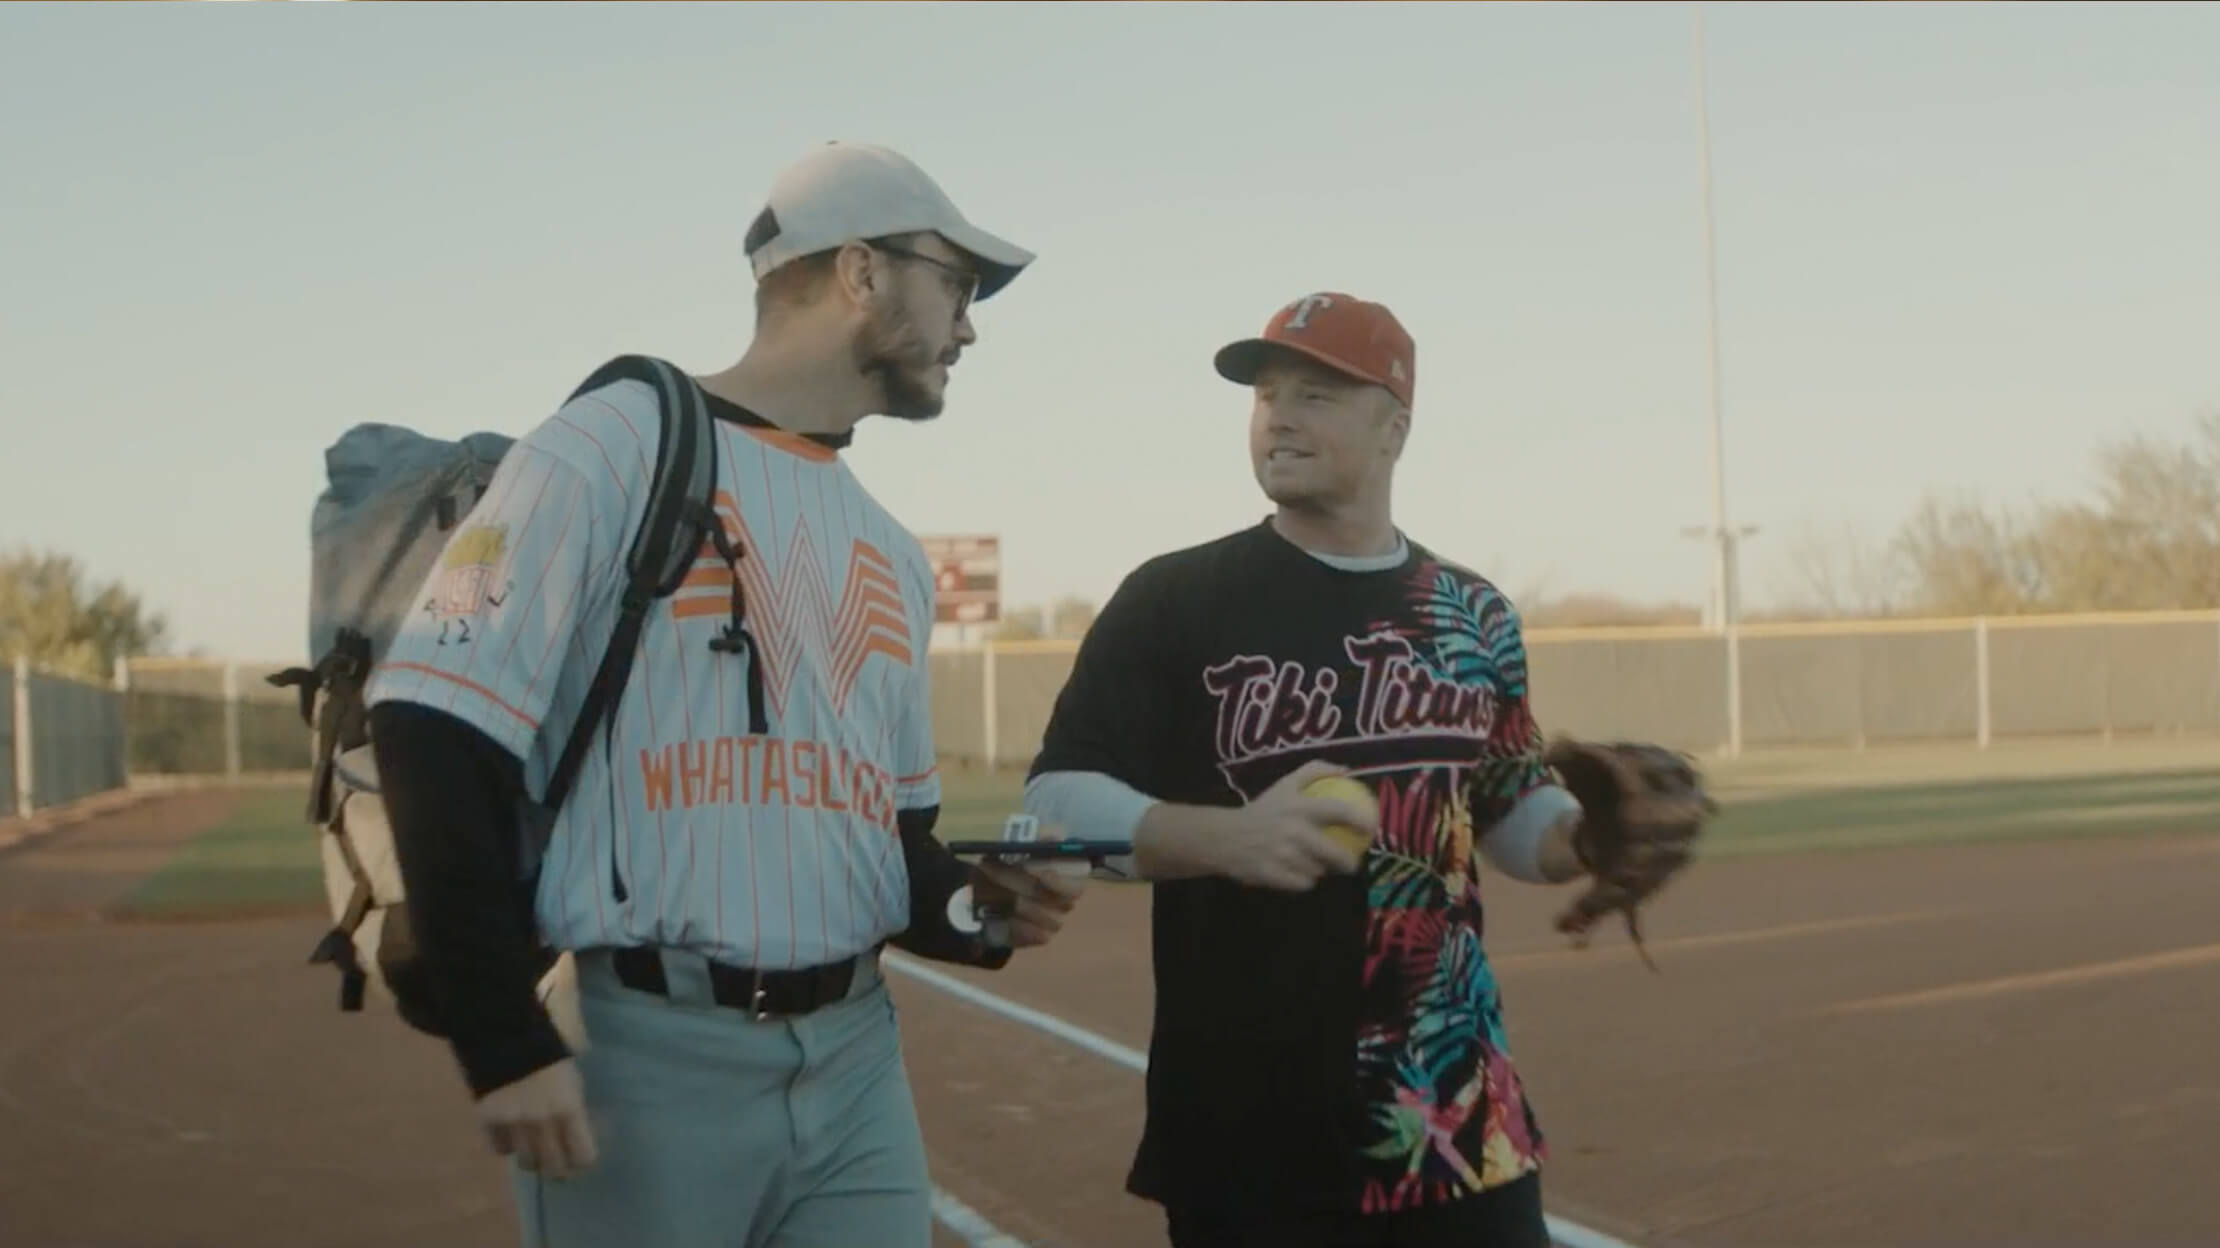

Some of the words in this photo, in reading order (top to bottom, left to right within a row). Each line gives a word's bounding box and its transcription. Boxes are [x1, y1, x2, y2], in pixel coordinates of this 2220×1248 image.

[1285, 295, 1332, 329] T
[1203, 655, 1341, 761] Tiki
[1344, 635, 1495, 738] Titans
